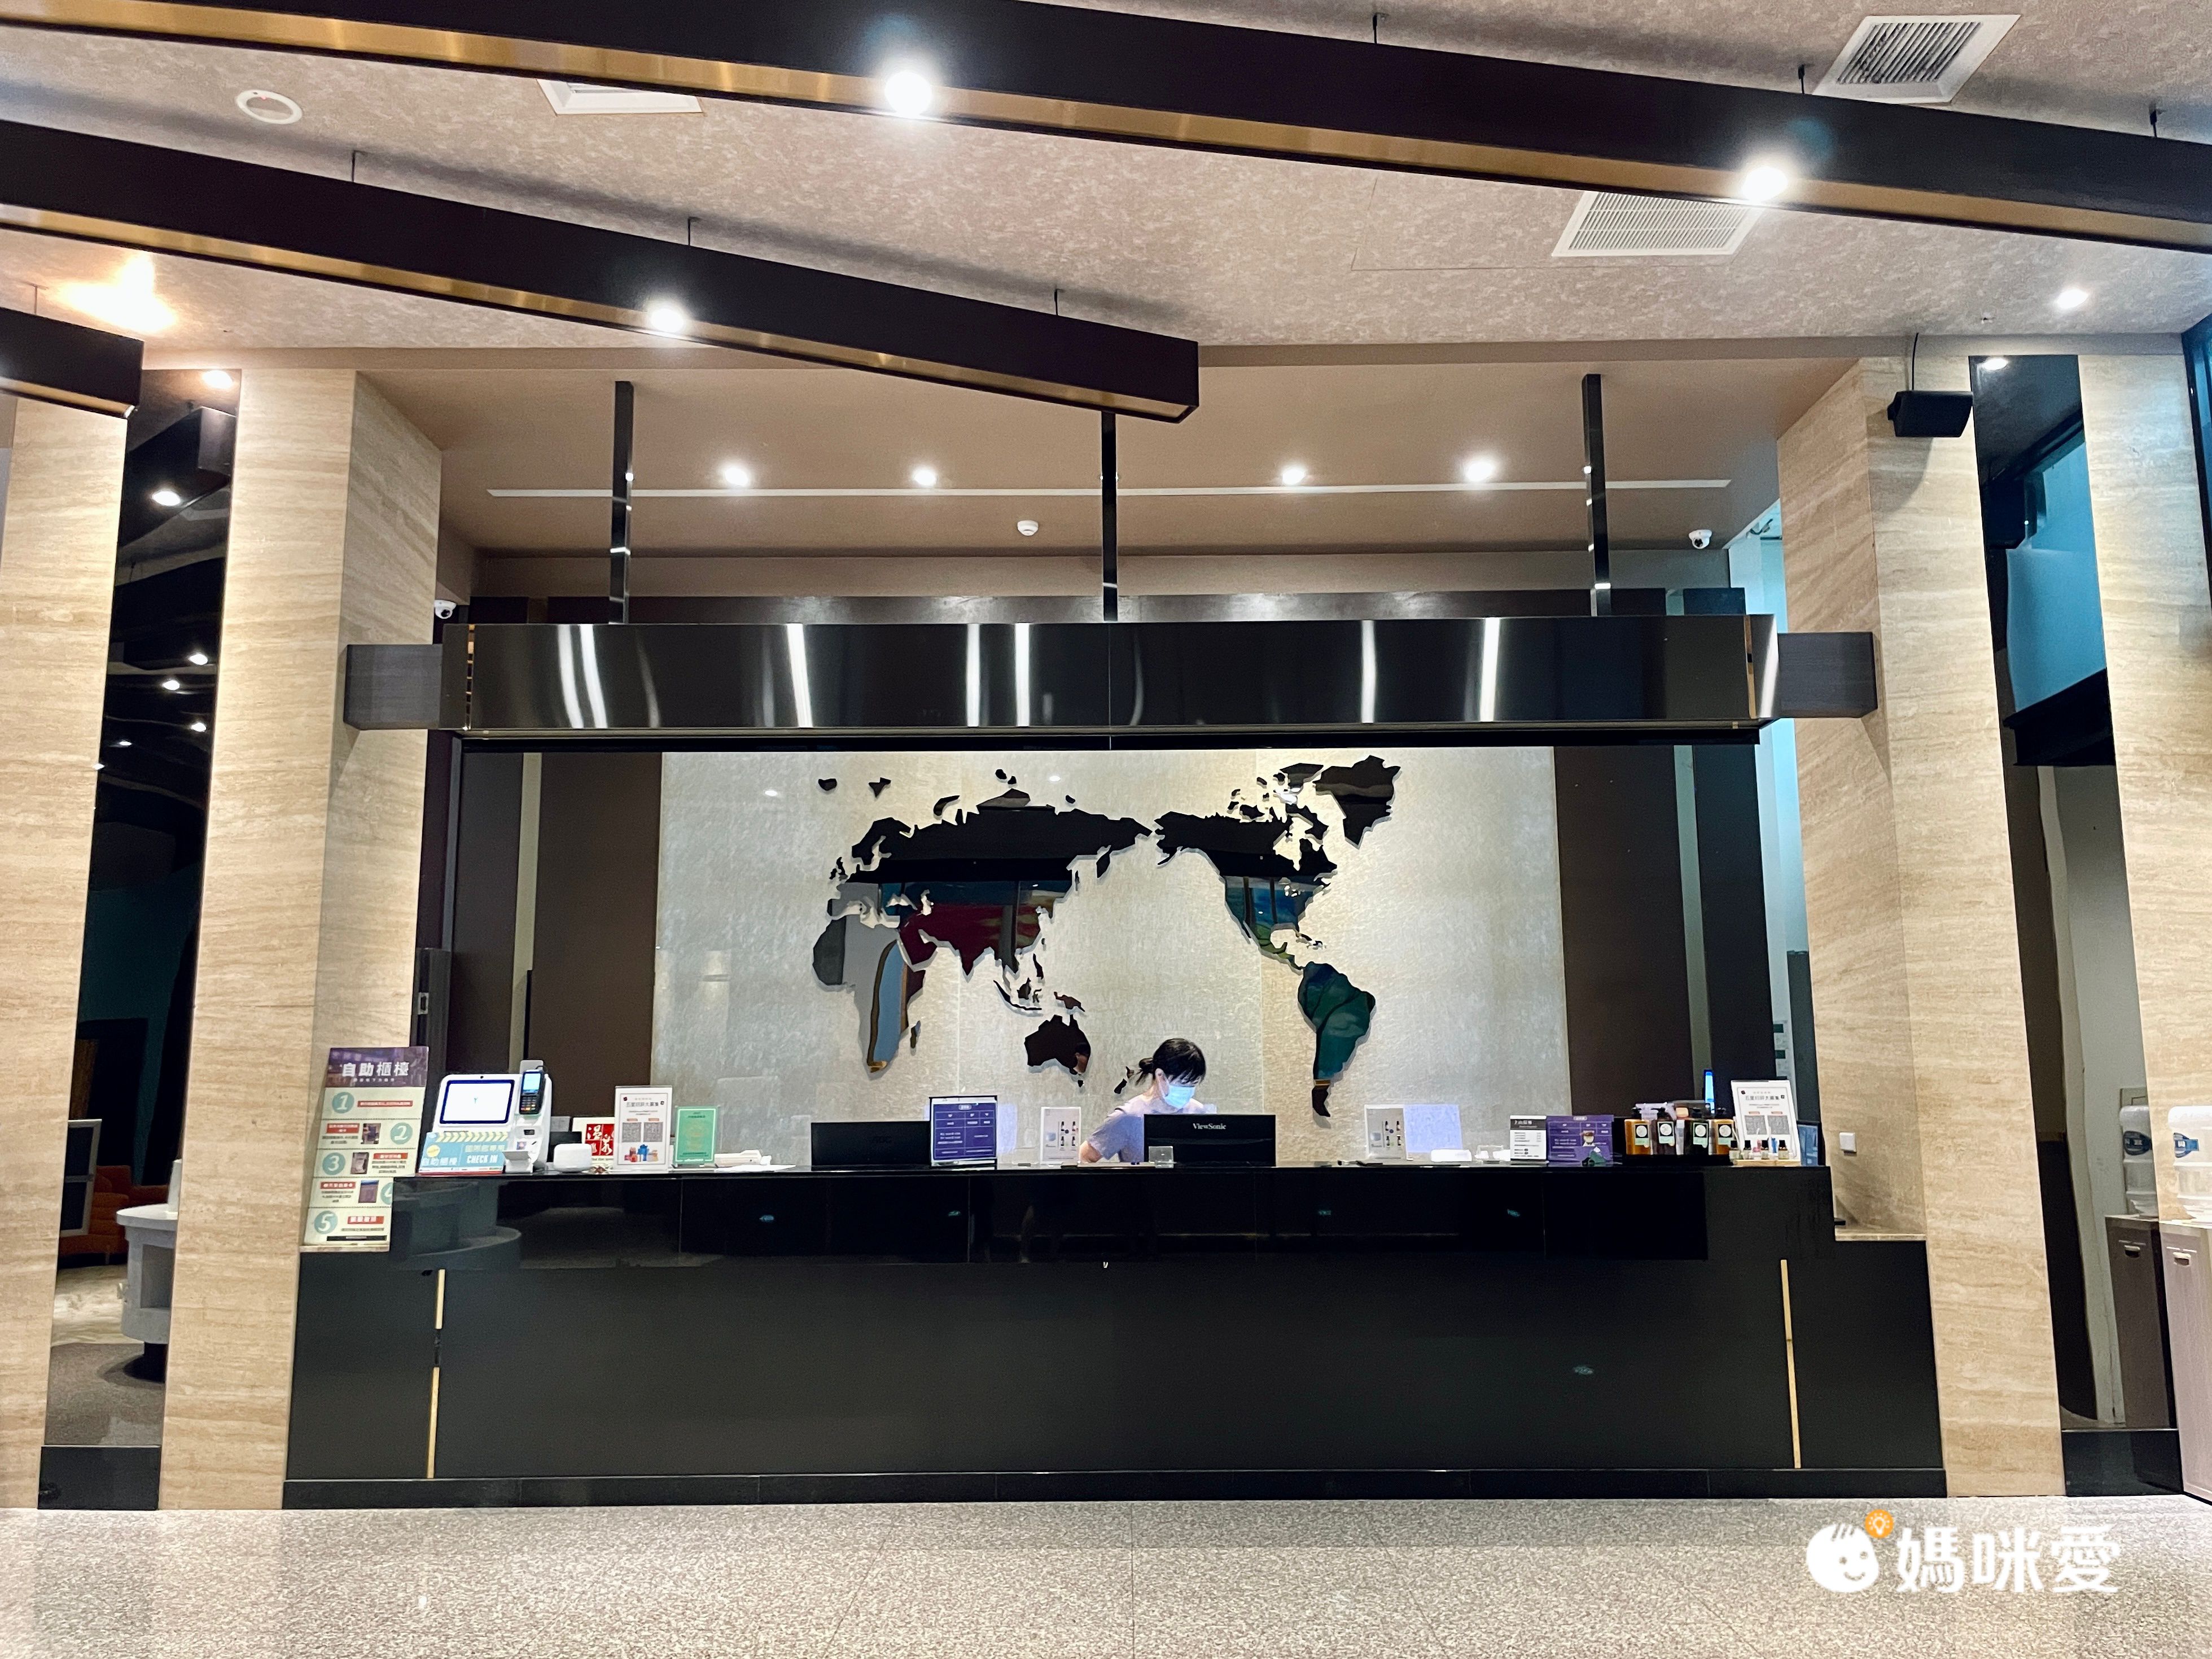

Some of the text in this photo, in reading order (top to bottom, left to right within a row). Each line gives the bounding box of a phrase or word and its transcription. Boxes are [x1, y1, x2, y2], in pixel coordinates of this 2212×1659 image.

[342, 1062, 410, 1077] 自助櫃檯
[336, 1094, 349, 1110] 1
[394, 1125, 408, 1140] 2
[327, 1155, 340, 1172] 3
[467, 1154, 498, 1164] CHECK IN
[318, 1213, 334, 1232] 5
